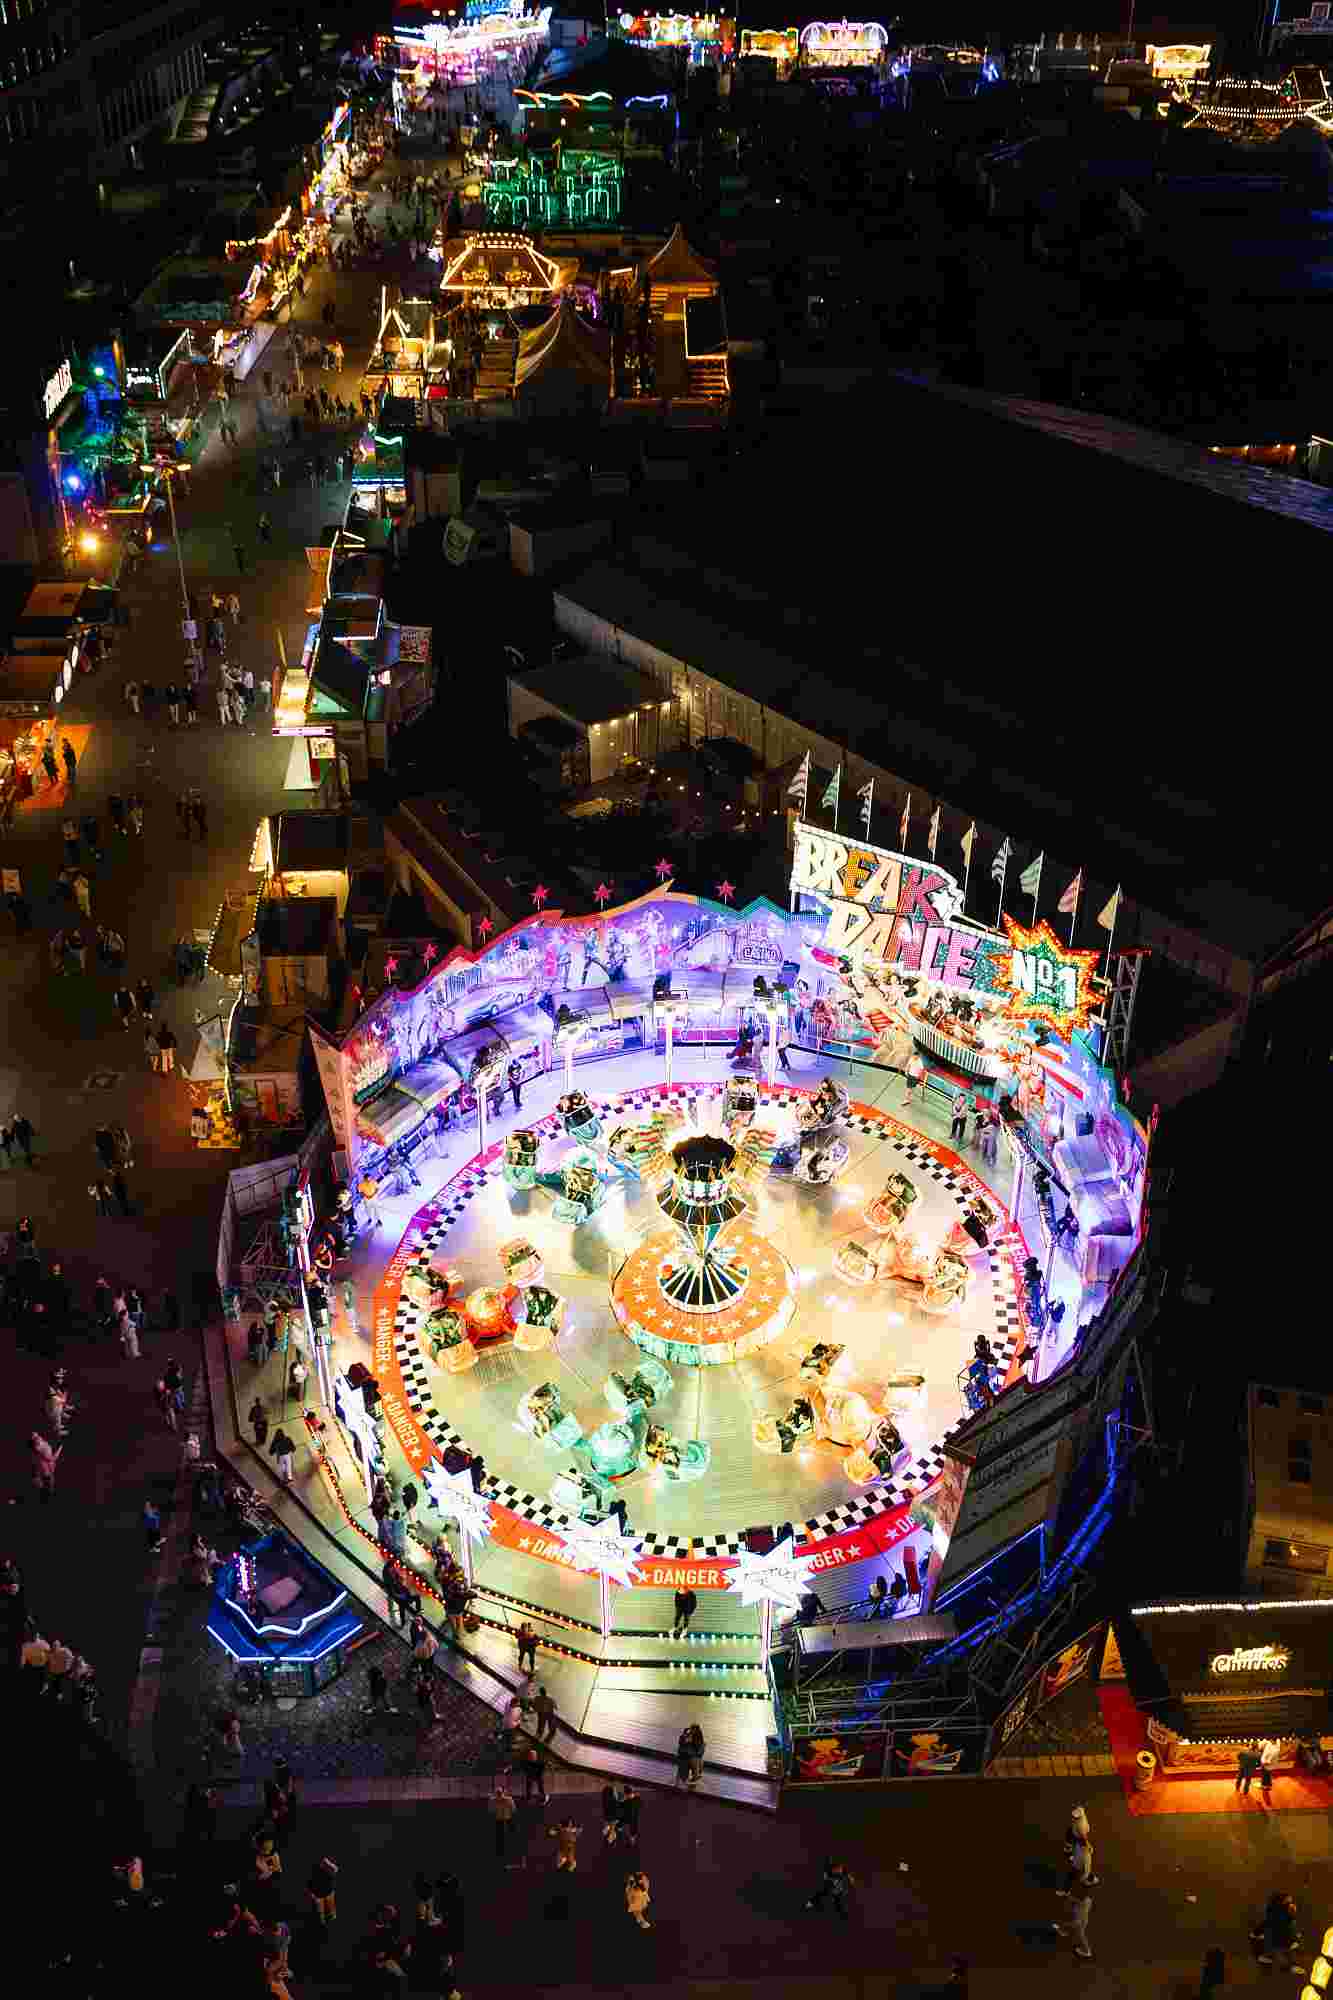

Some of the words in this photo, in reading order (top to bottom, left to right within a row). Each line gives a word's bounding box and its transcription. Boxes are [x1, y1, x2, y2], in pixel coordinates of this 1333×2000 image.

[803, 832, 945, 921] BREAK
[828, 898, 981, 989] DANCE
[376, 1318, 392, 1361] DANGER
[386, 1401, 418, 1448] DANGER
[653, 1568, 720, 1585] DANGER
